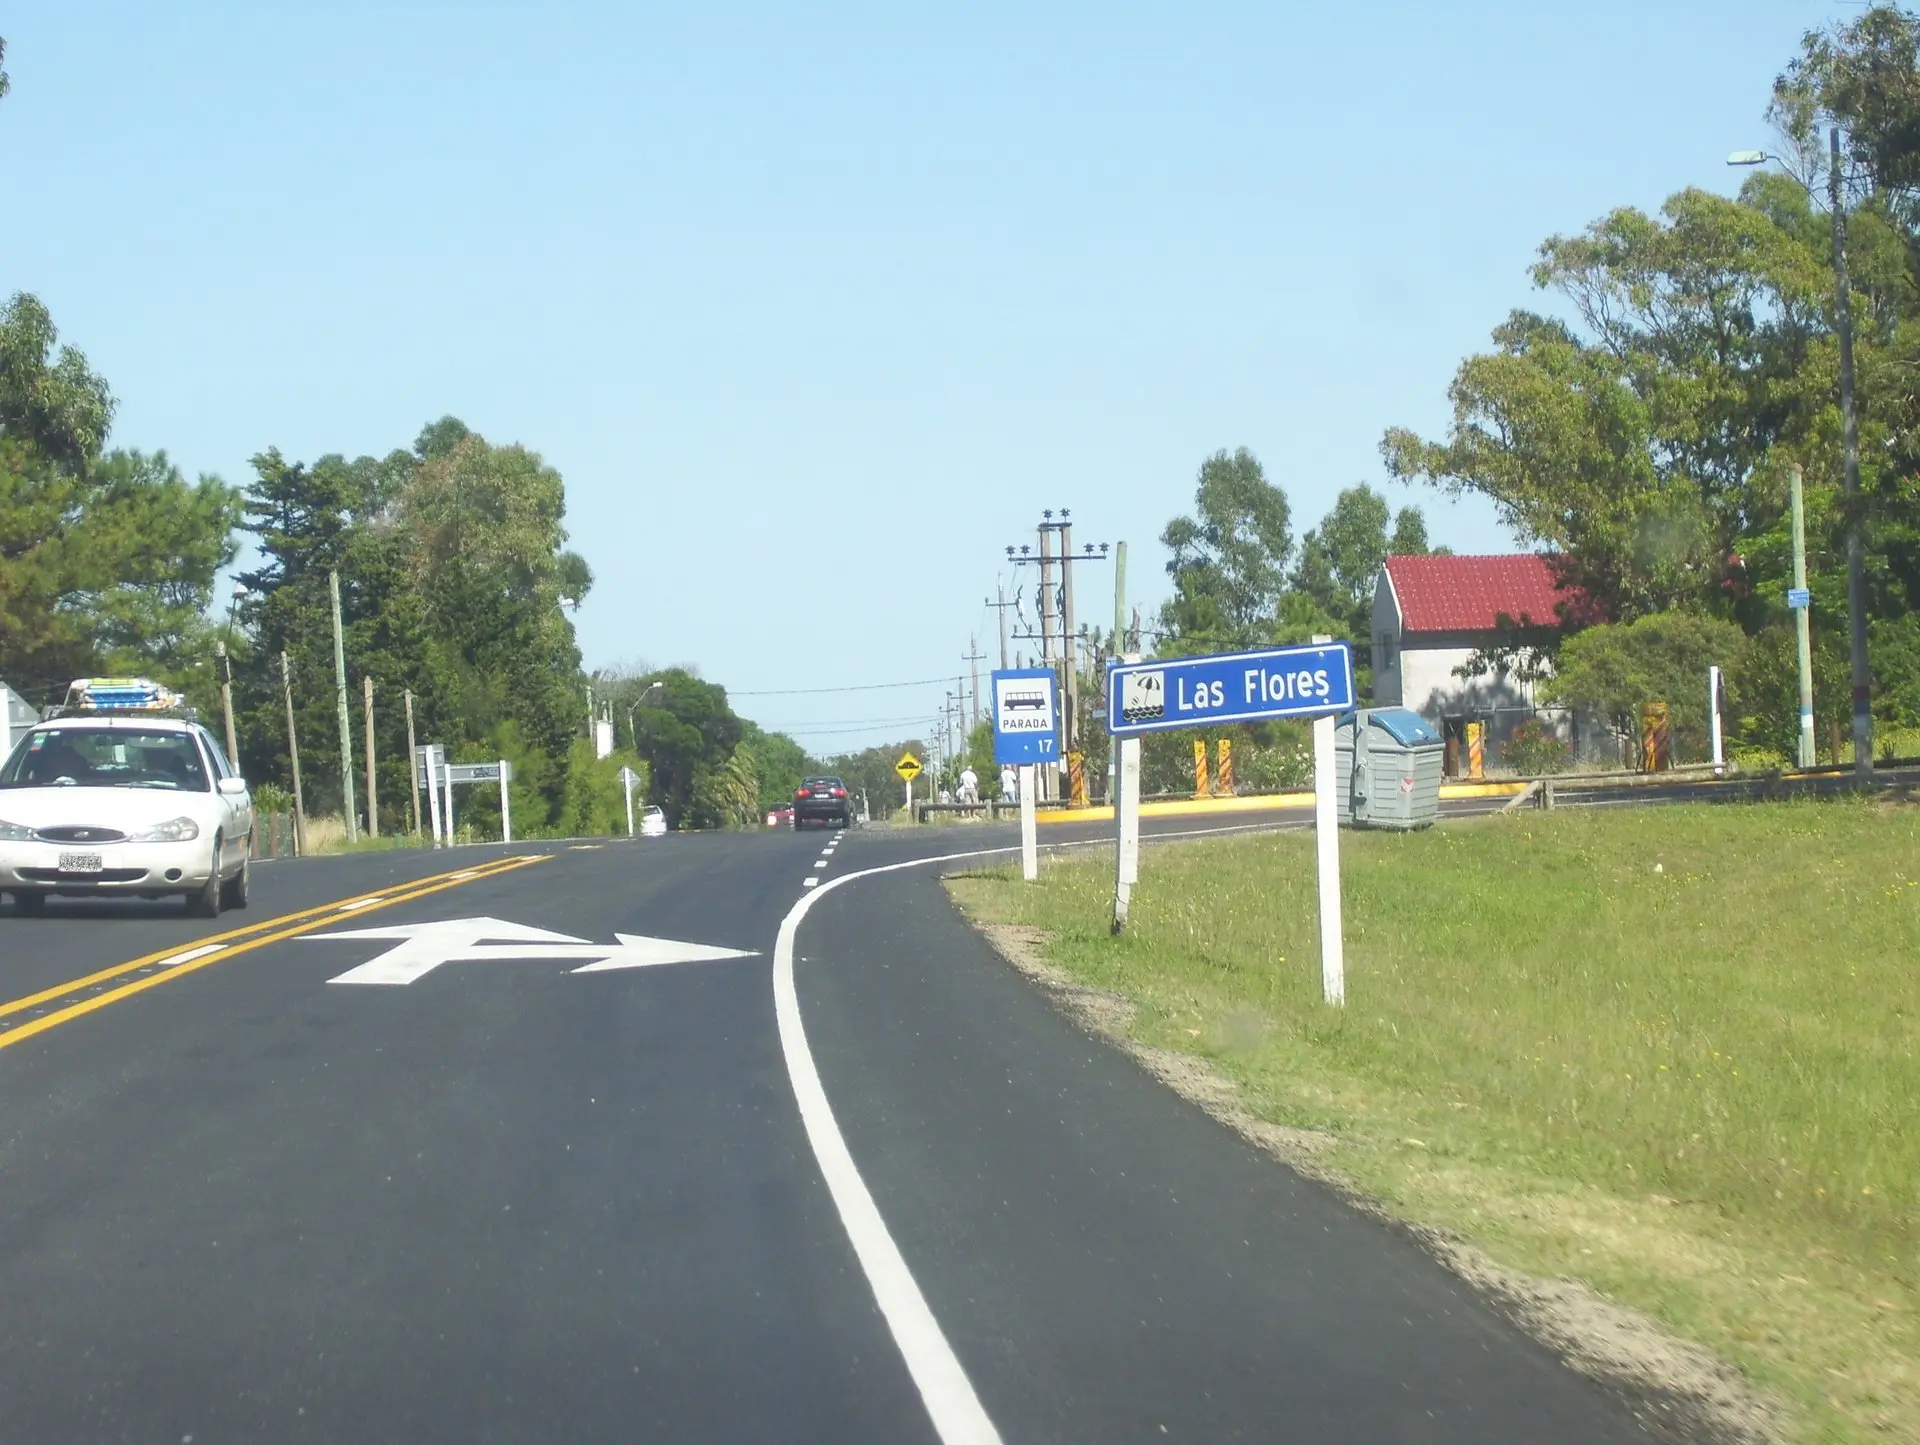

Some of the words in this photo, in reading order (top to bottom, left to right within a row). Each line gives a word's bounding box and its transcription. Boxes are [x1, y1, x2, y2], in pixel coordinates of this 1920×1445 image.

[1178, 677, 1224, 711] Las
[1244, 668, 1330, 704] Flores
[1003, 718, 1048, 729] PARADA
[1038, 739, 1053, 753] 17
